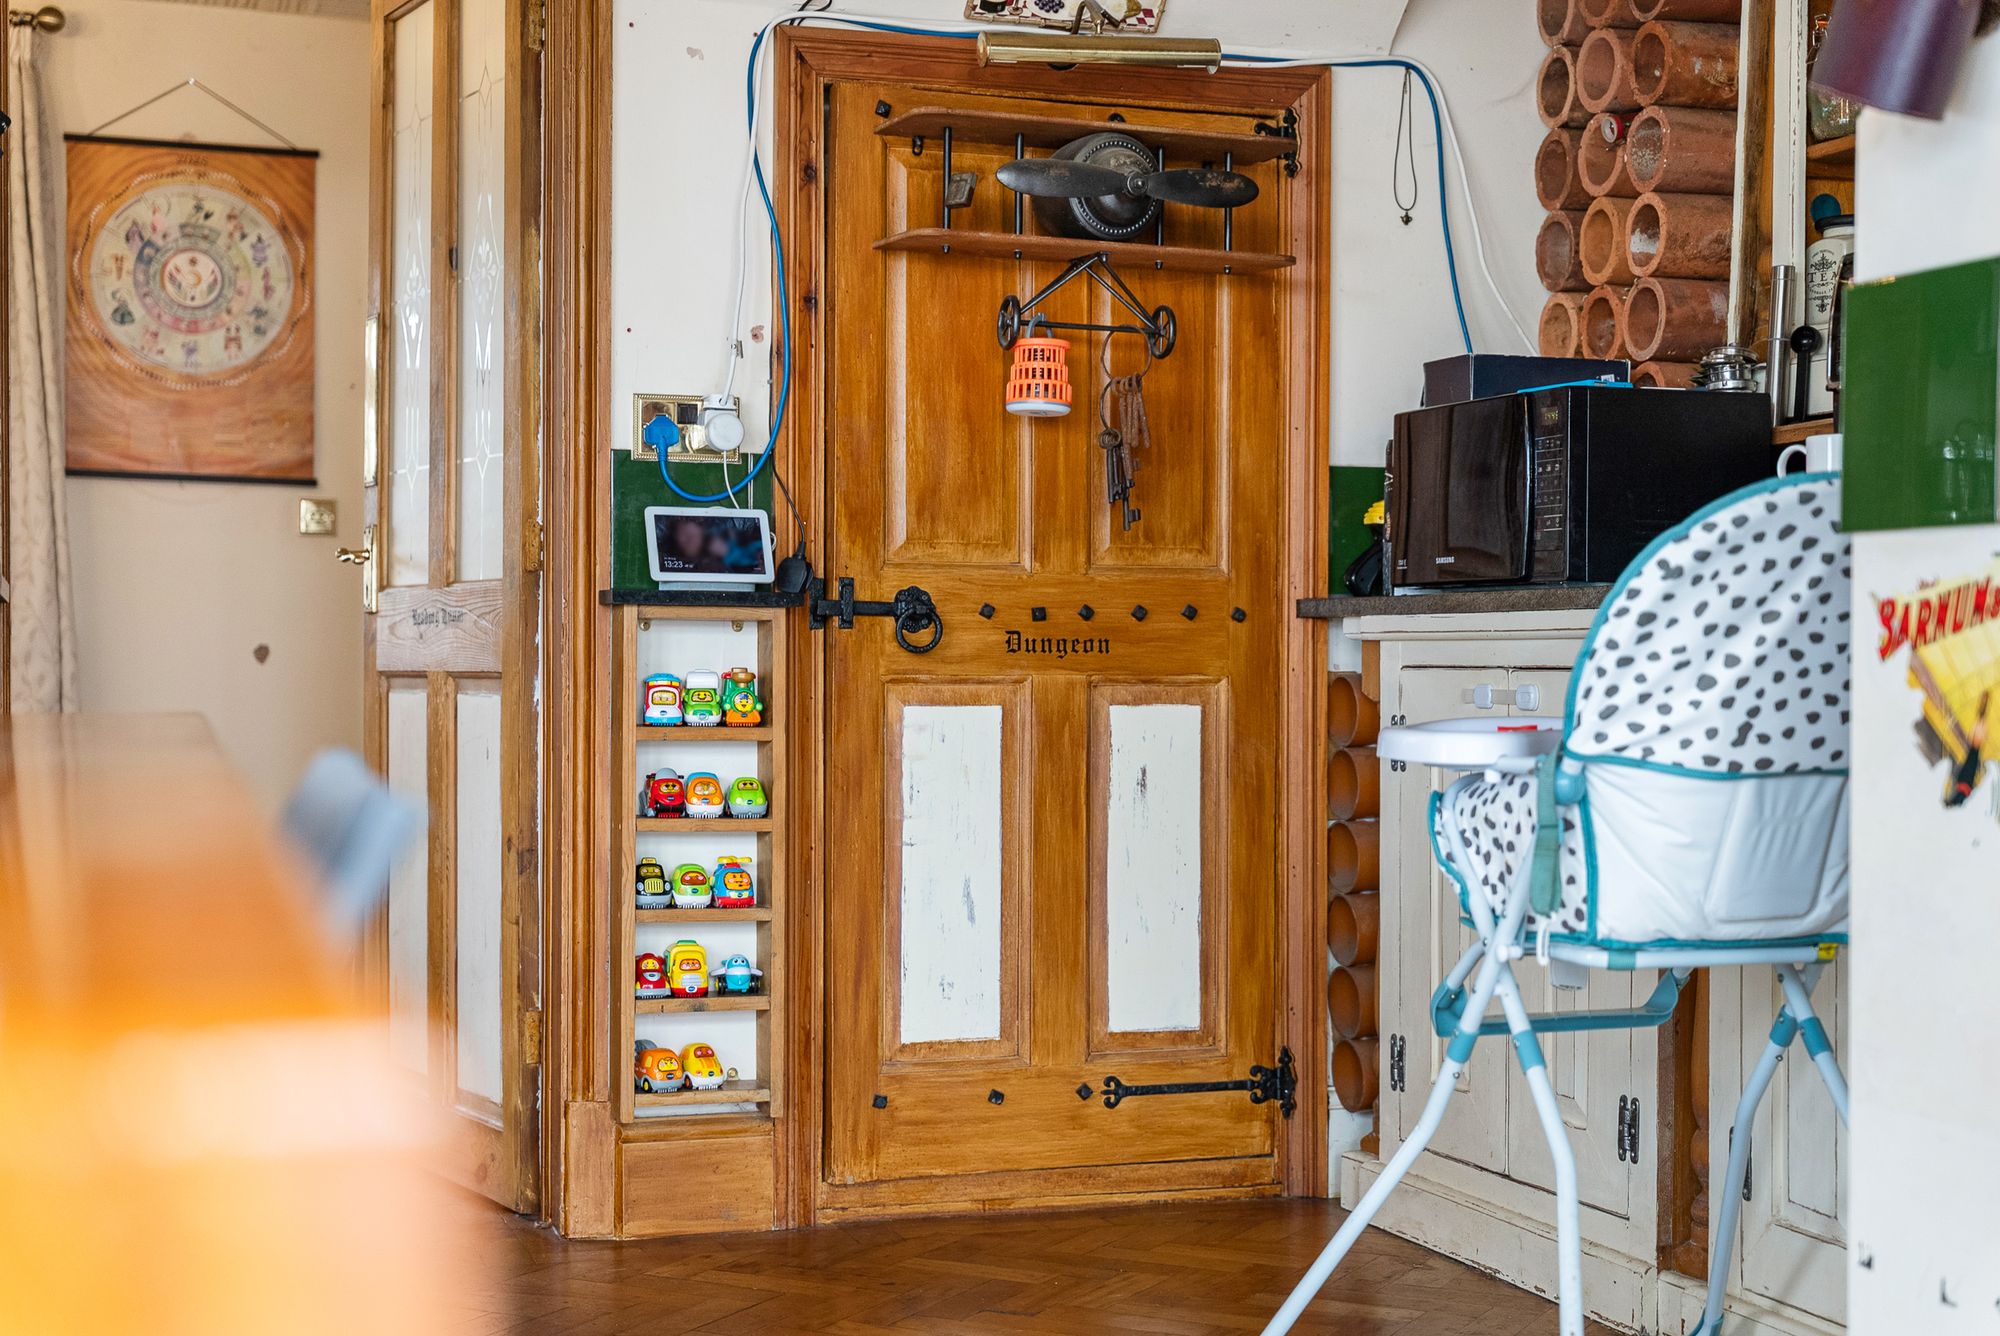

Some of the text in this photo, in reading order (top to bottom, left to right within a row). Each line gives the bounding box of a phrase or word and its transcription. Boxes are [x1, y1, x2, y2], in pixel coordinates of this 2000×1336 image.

[1808, 271, 1838, 284] TEA
[664, 560, 684, 568] 13:23
[1436, 556, 1455, 565] SAMSUNG
[1005, 629, 1111, 659] Dungeon
